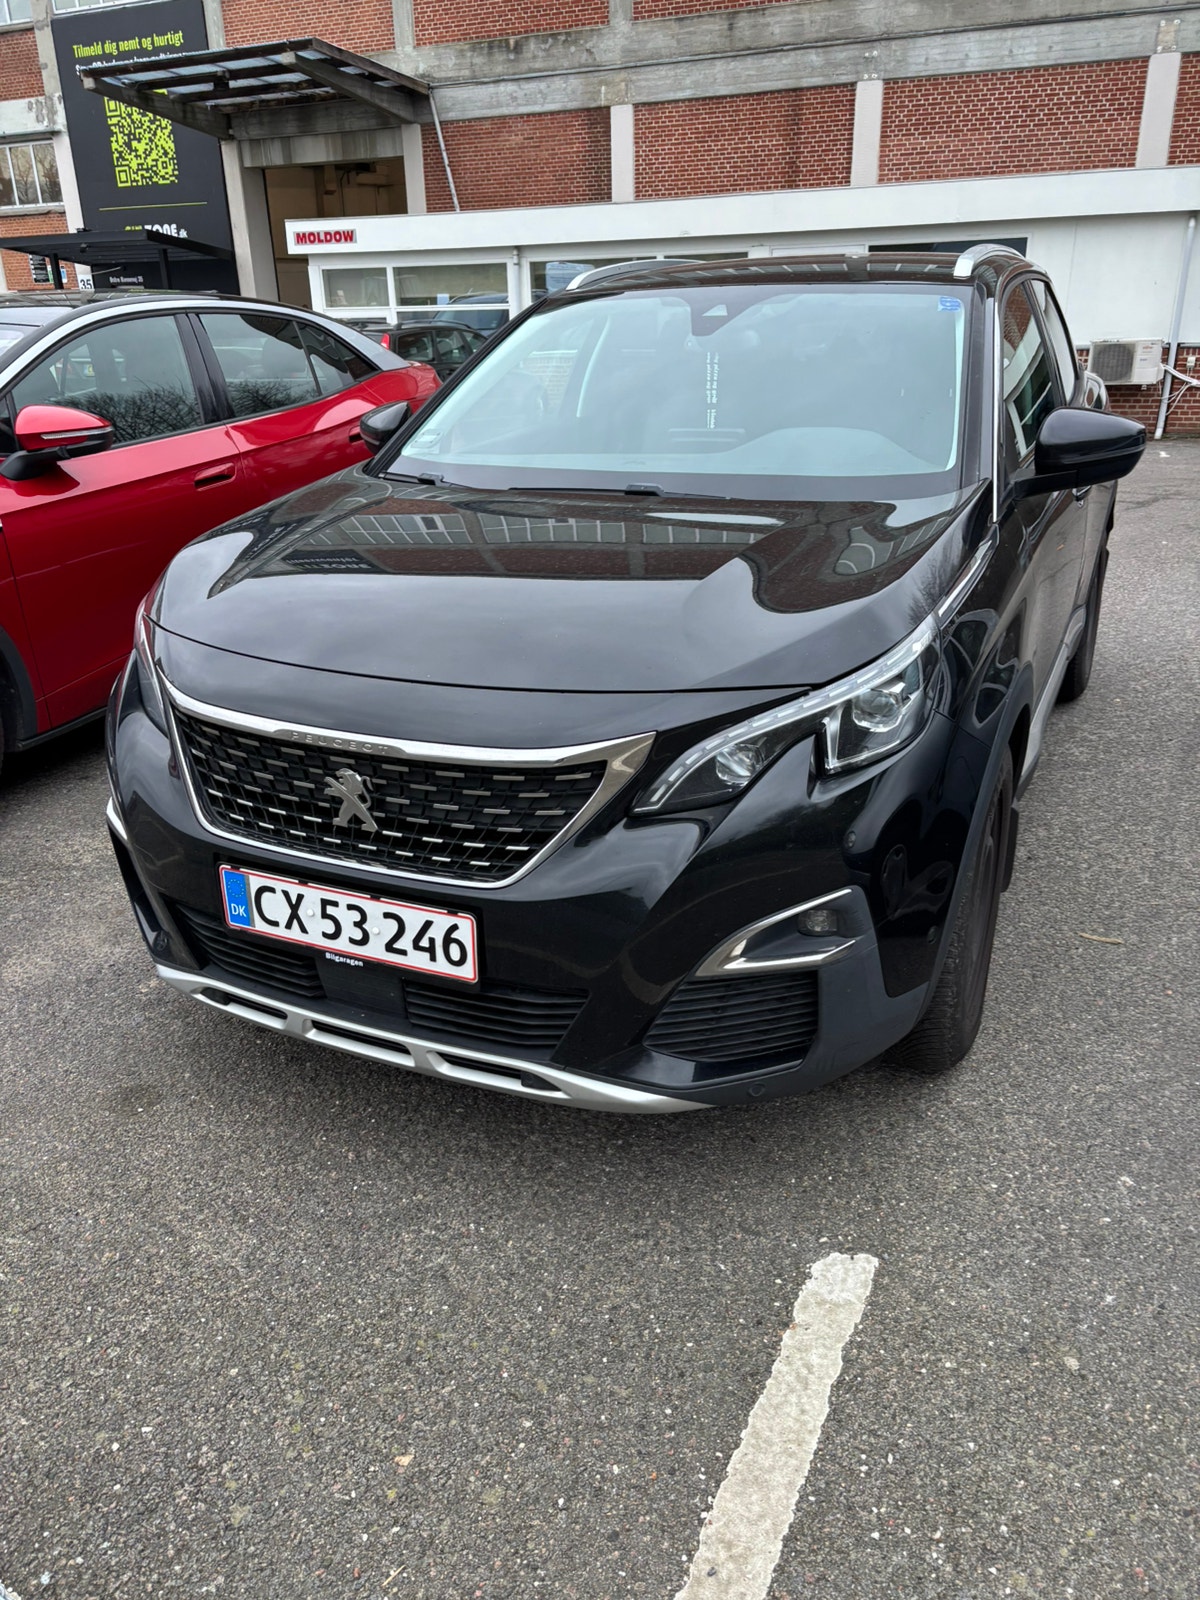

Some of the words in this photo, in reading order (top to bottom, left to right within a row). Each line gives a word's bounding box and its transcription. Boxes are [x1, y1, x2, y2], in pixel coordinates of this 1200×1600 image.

[72, 41, 103, 58] Tilmeld
[104, 40, 118, 55] dig
[119, 36, 140, 52] nemt
[141, 36, 153, 50] og
[153, 30, 184, 47] hurtigt
[295, 230, 354, 245] MOLDOW
[80, 278, 93, 290] 35
[291, 731, 389, 755] PEUGEOT
[231, 903, 247, 918] DK
[254, 885, 309, 935] CX
[319, 897, 371, 947] 53
[382, 911, 468, 968] 246
[325, 951, 364, 968] Bilgaragen
